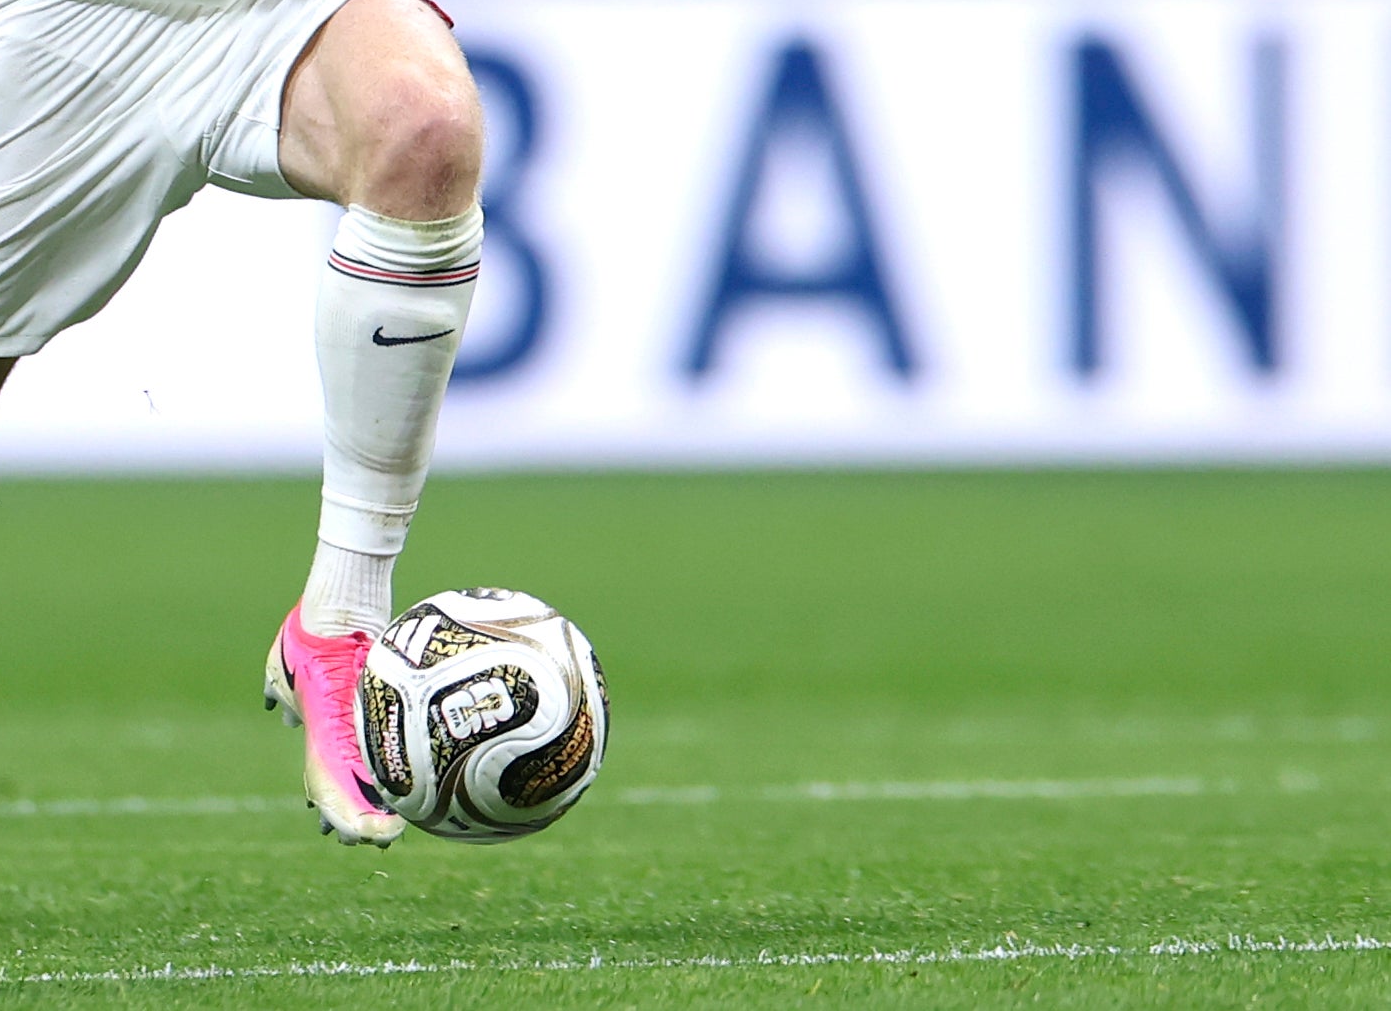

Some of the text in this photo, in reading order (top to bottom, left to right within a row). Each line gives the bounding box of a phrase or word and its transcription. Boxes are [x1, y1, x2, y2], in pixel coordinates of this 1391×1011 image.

[386, 703, 406, 783] TRIONDA
[448, 707, 462, 729] FIFA
[381, 731, 397, 782] FINAL
